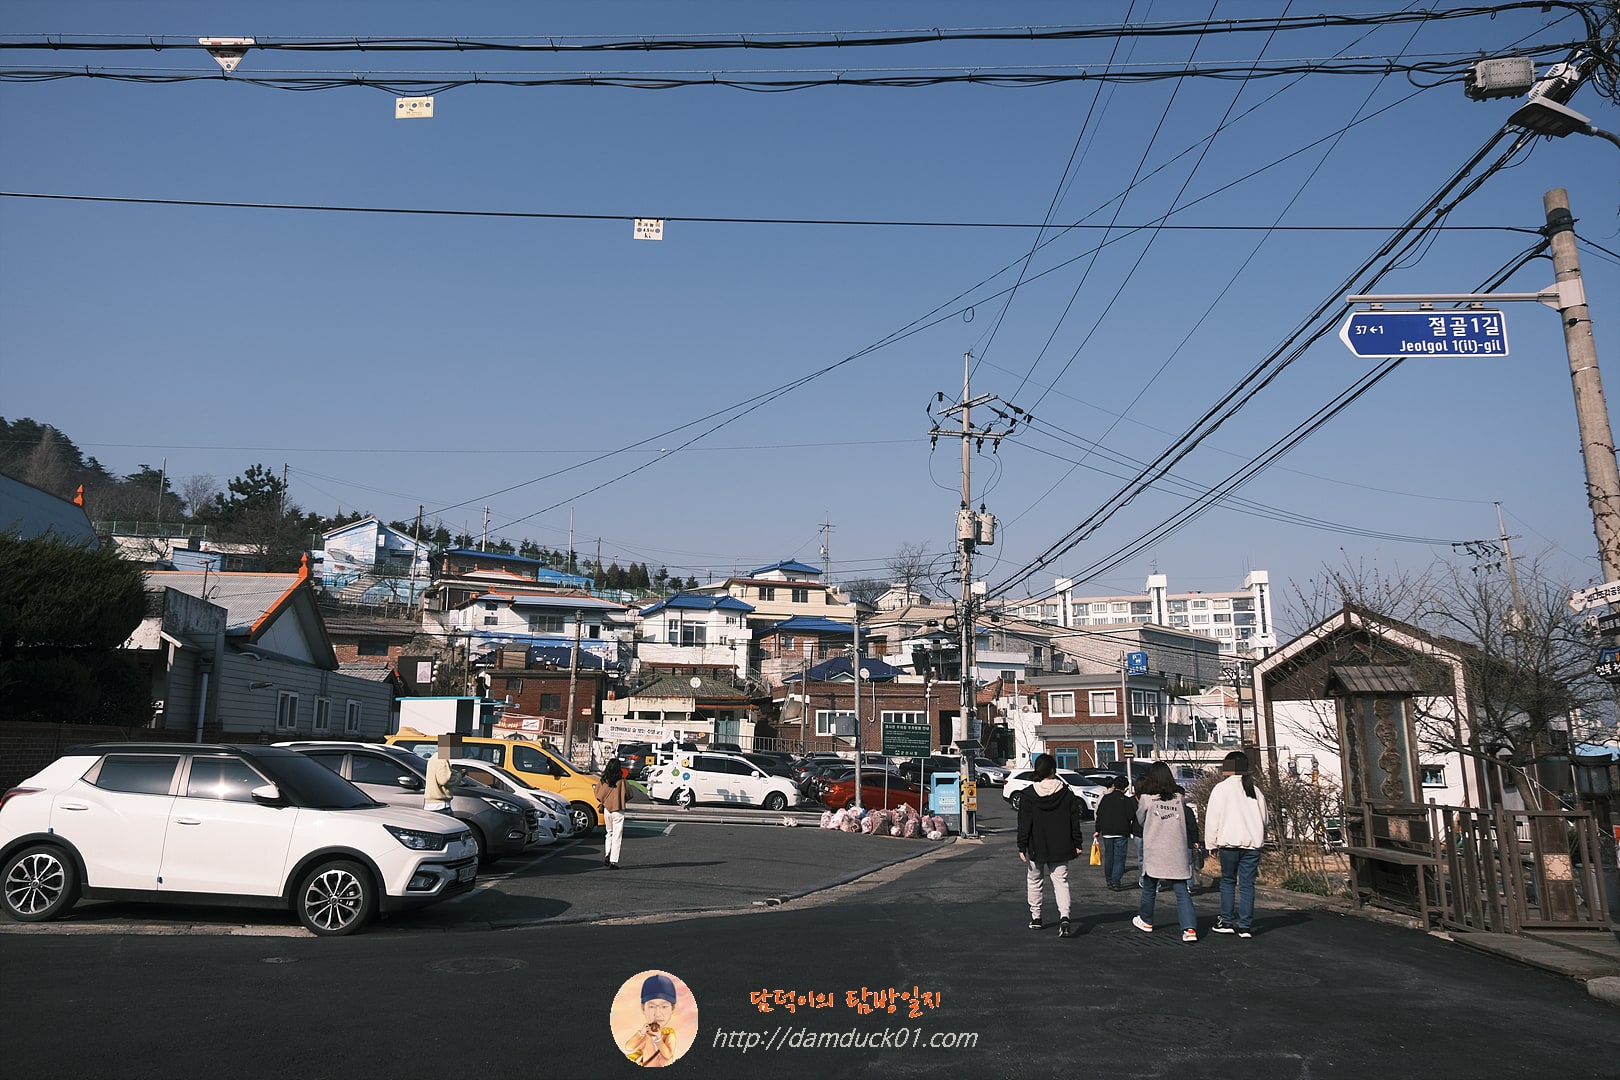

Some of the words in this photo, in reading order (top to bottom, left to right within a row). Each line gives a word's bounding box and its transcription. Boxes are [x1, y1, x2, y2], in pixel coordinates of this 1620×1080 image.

[1355, 325, 1367, 335] 37
[1379, 325, 1384, 335] 1
[1428, 316, 1500, 337] 절골1길
[1400, 340, 1448, 354] Jeolgol
[1451, 339, 1501, 354] 1(il)-gil
[1595, 663, 1612, 676] 전북
[1160, 804, 1178, 812] DESIRE
